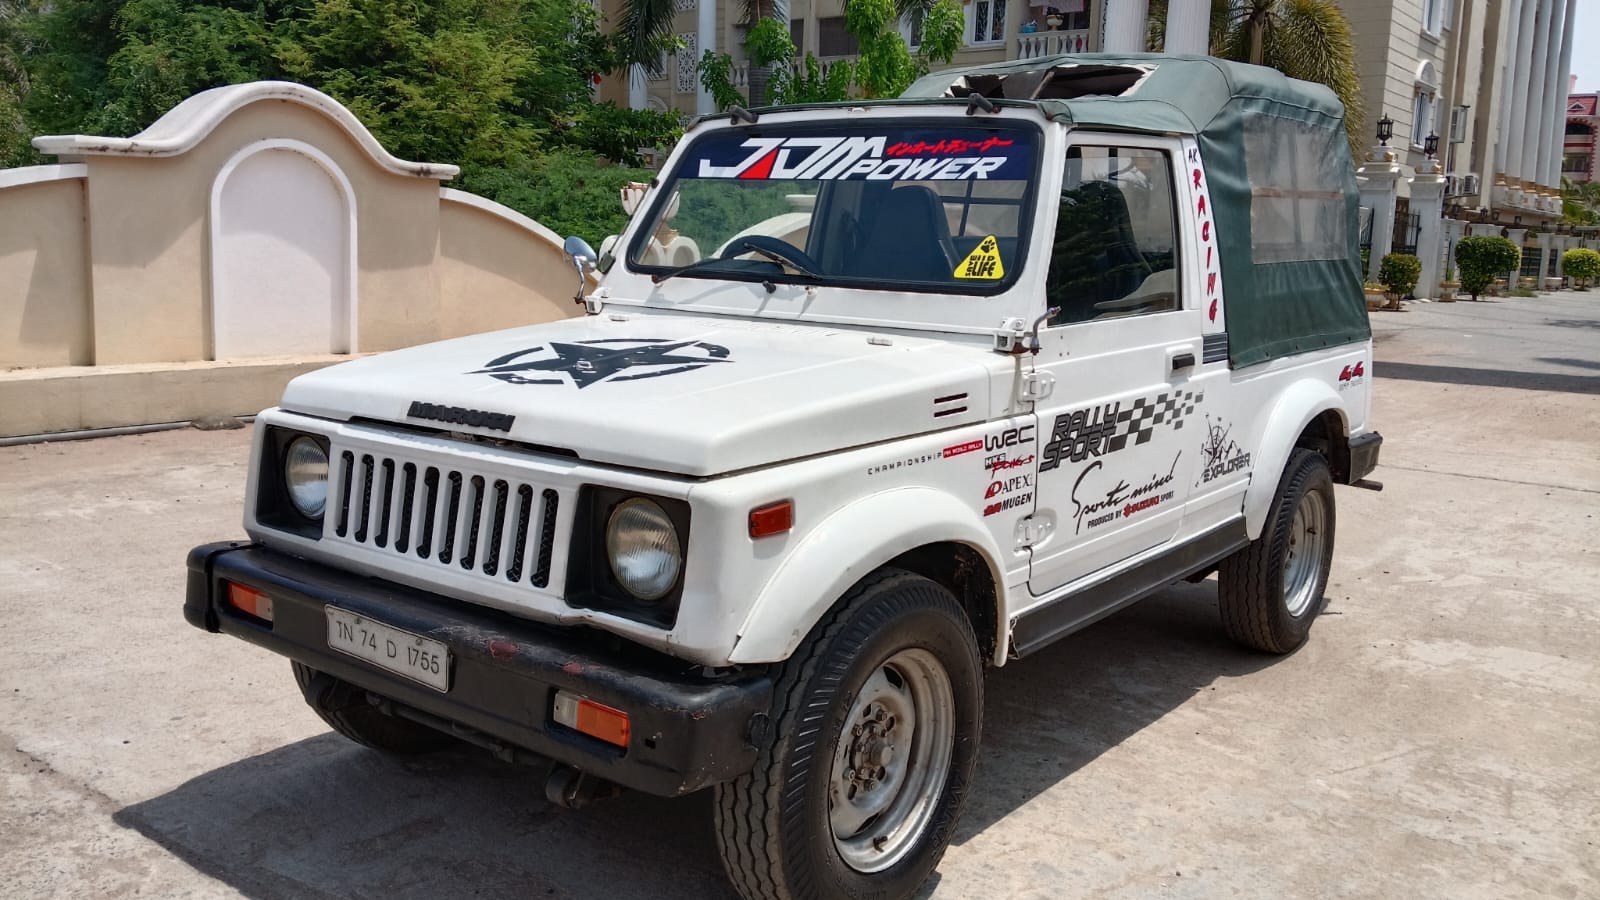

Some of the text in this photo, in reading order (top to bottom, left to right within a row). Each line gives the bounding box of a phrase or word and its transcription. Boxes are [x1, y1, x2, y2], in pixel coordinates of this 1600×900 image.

[698, 136, 1008, 180] JDM POWER
[972, 261, 996, 276] LIFE
[985, 425, 1034, 452] WRC
[1051, 401, 1120, 442] RALLY
[868, 452, 942, 475] CHAMPIONSHIP
[1039, 426, 1117, 473] SPORT
[1203, 452, 1251, 483] EXPLORER
[1002, 492, 1032, 511] MUGEN
[1087, 512, 1115, 529] PRODUCED
[1115, 509, 1123, 519] BY
[1160, 490, 1174, 502] SPORT
[335, 620, 440, 674] TN 74 D 1755
